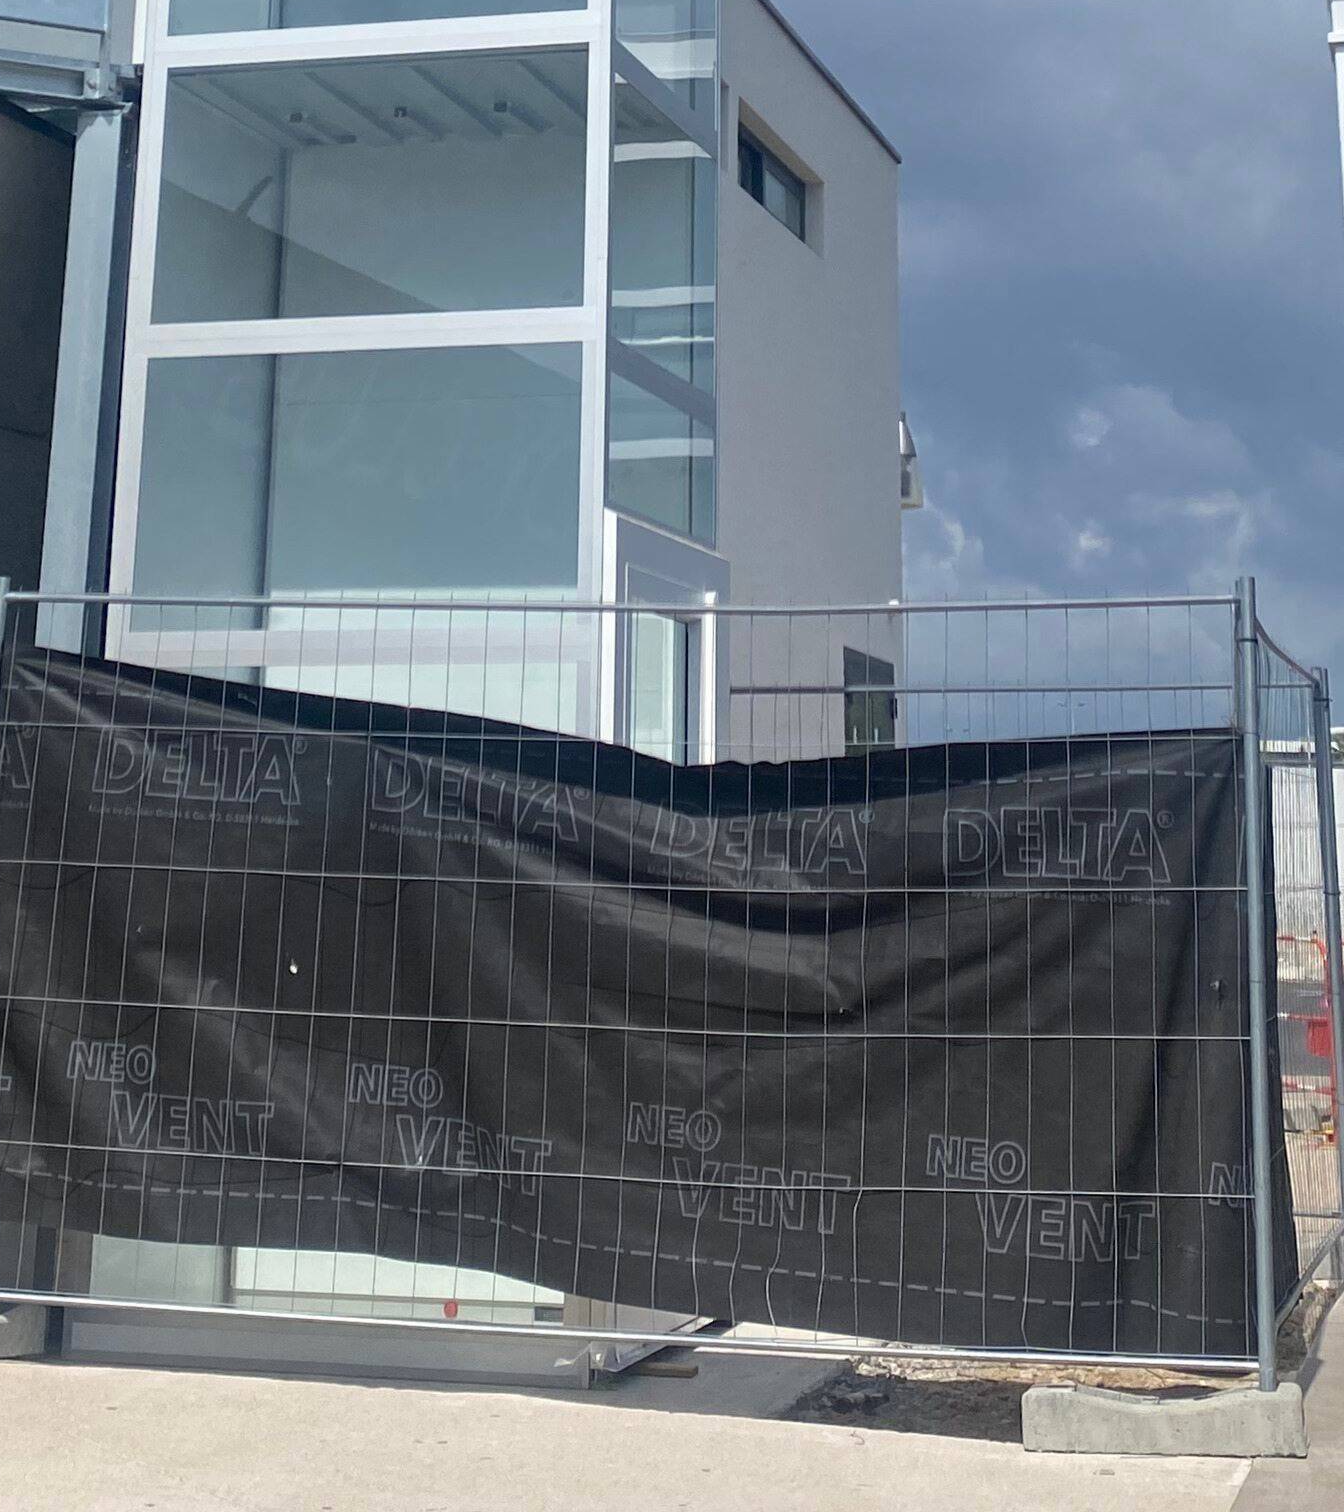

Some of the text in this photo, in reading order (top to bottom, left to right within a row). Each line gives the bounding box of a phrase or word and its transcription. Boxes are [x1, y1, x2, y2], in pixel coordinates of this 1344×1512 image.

[67, 1040, 156, 1084] NEO
[349, 1063, 444, 1108] NEO
[111, 1091, 274, 1156] VENT
[627, 1101, 723, 1153] NEO
[395, 1114, 552, 1196] VENT
[925, 1134, 1026, 1185] NEO
[672, 1156, 851, 1235] VENT
[974, 1193, 1156, 1264] VENT
